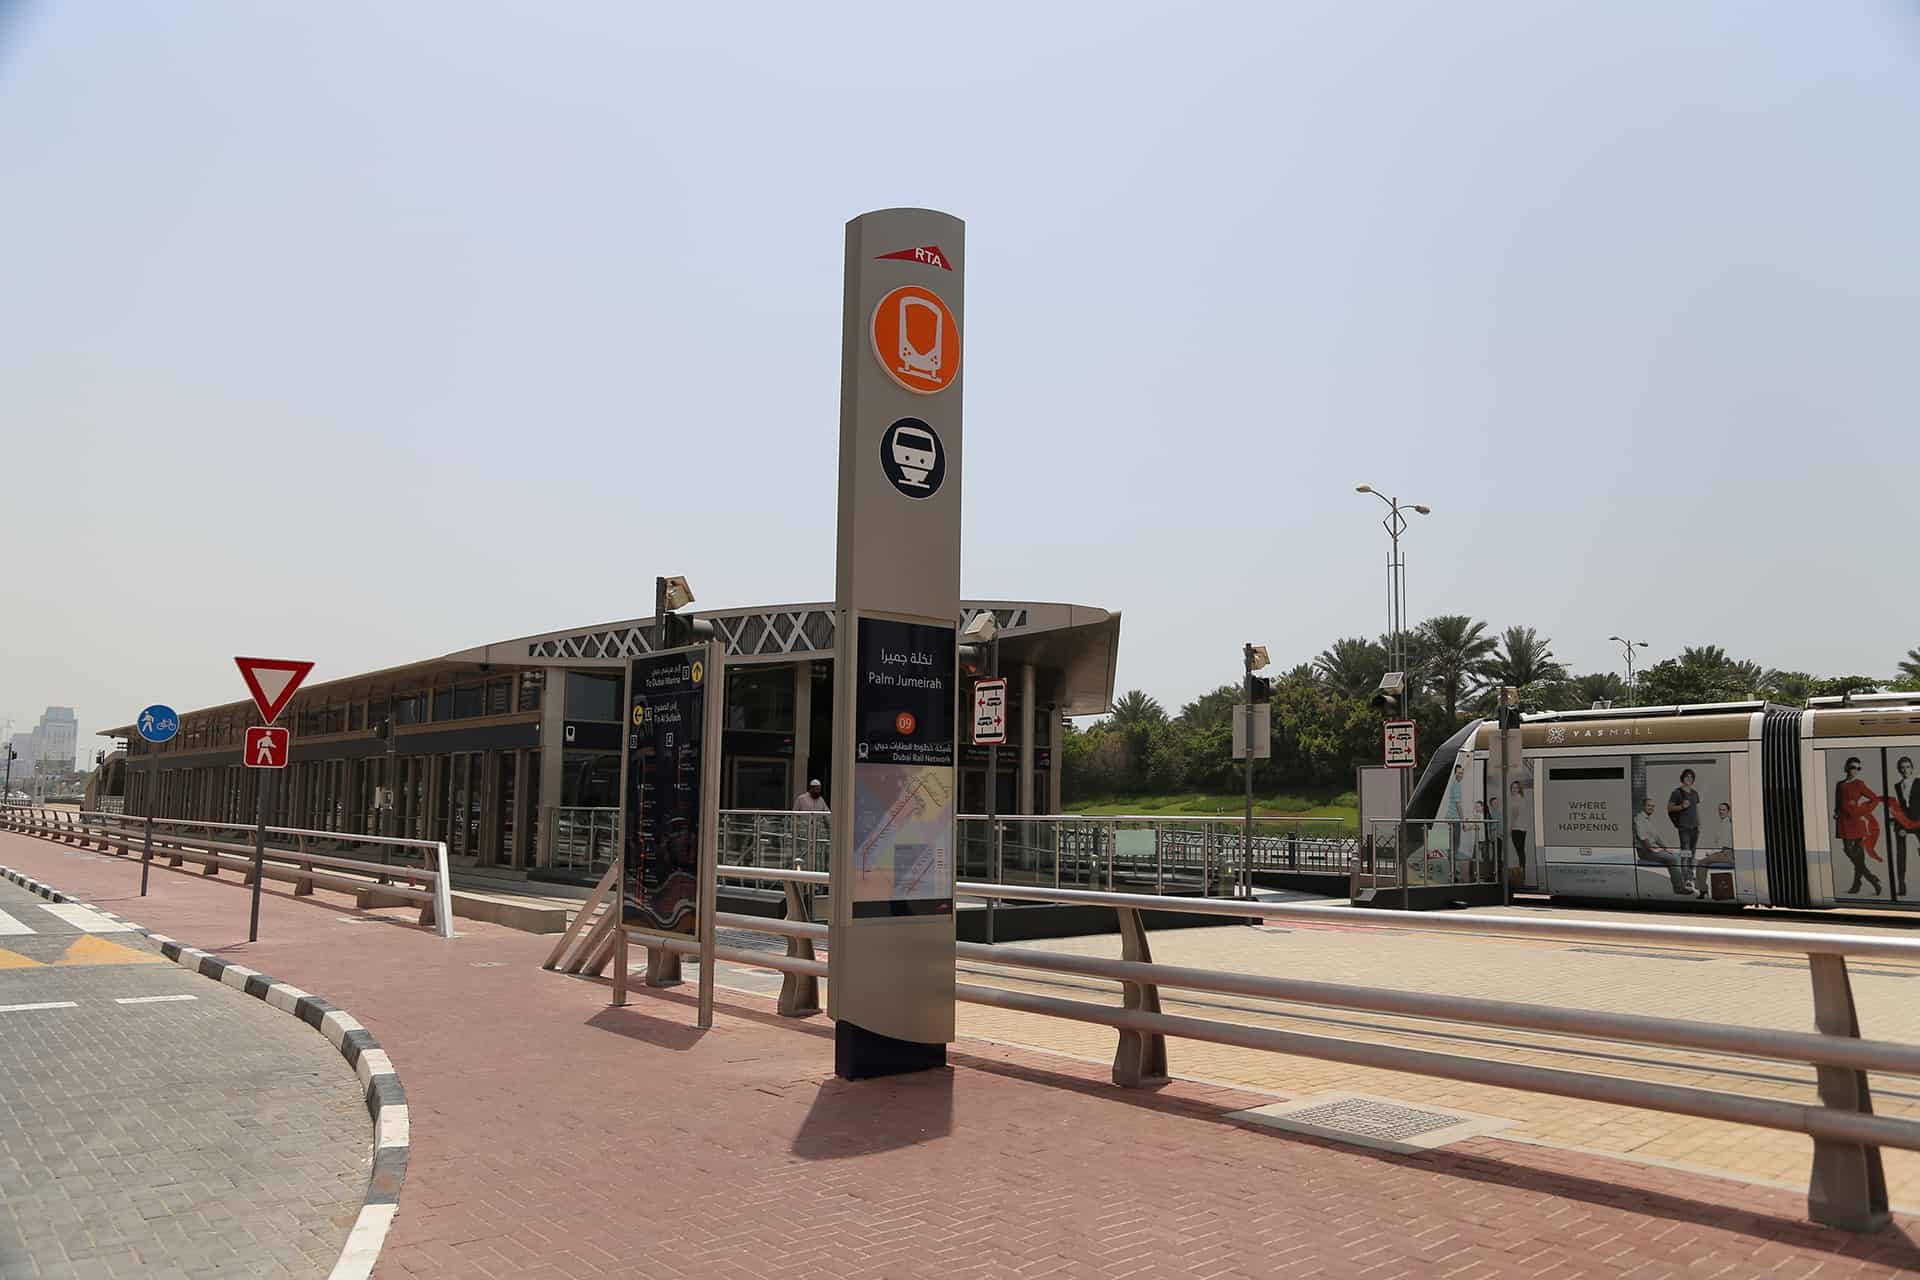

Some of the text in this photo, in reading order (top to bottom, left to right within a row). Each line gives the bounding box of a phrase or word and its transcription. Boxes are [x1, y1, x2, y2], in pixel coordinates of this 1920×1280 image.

[914, 247, 943, 268] RTA
[880, 647, 934, 666] نخلة جميرا
[868, 671, 942, 689] Palm Jumeirah
[899, 718, 912, 729] 09
[892, 752, 911, 761] Dubai
[912, 753, 924, 762] Rail
[1568, 801, 1608, 810] WHERE
[1568, 812, 1608, 821] IT'S ALL
[1558, 823, 1619, 832] HAPPENING
